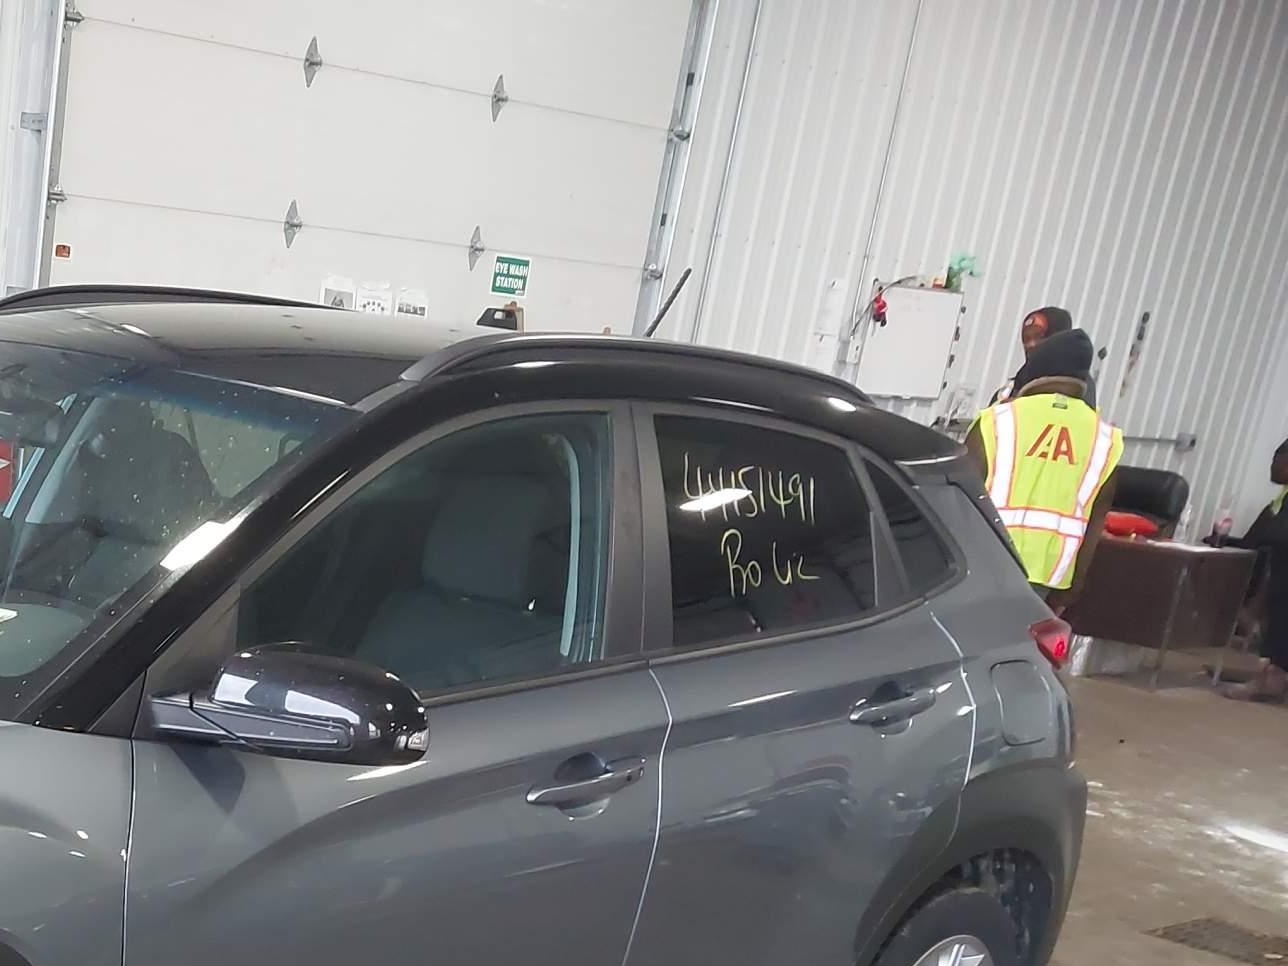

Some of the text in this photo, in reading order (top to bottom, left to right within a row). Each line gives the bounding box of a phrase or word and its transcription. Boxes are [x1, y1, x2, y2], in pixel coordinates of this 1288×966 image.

[495, 262, 529, 276] EYE WASH
[495, 276, 523, 289] STATION
[683, 452, 817, 526] 44151491
